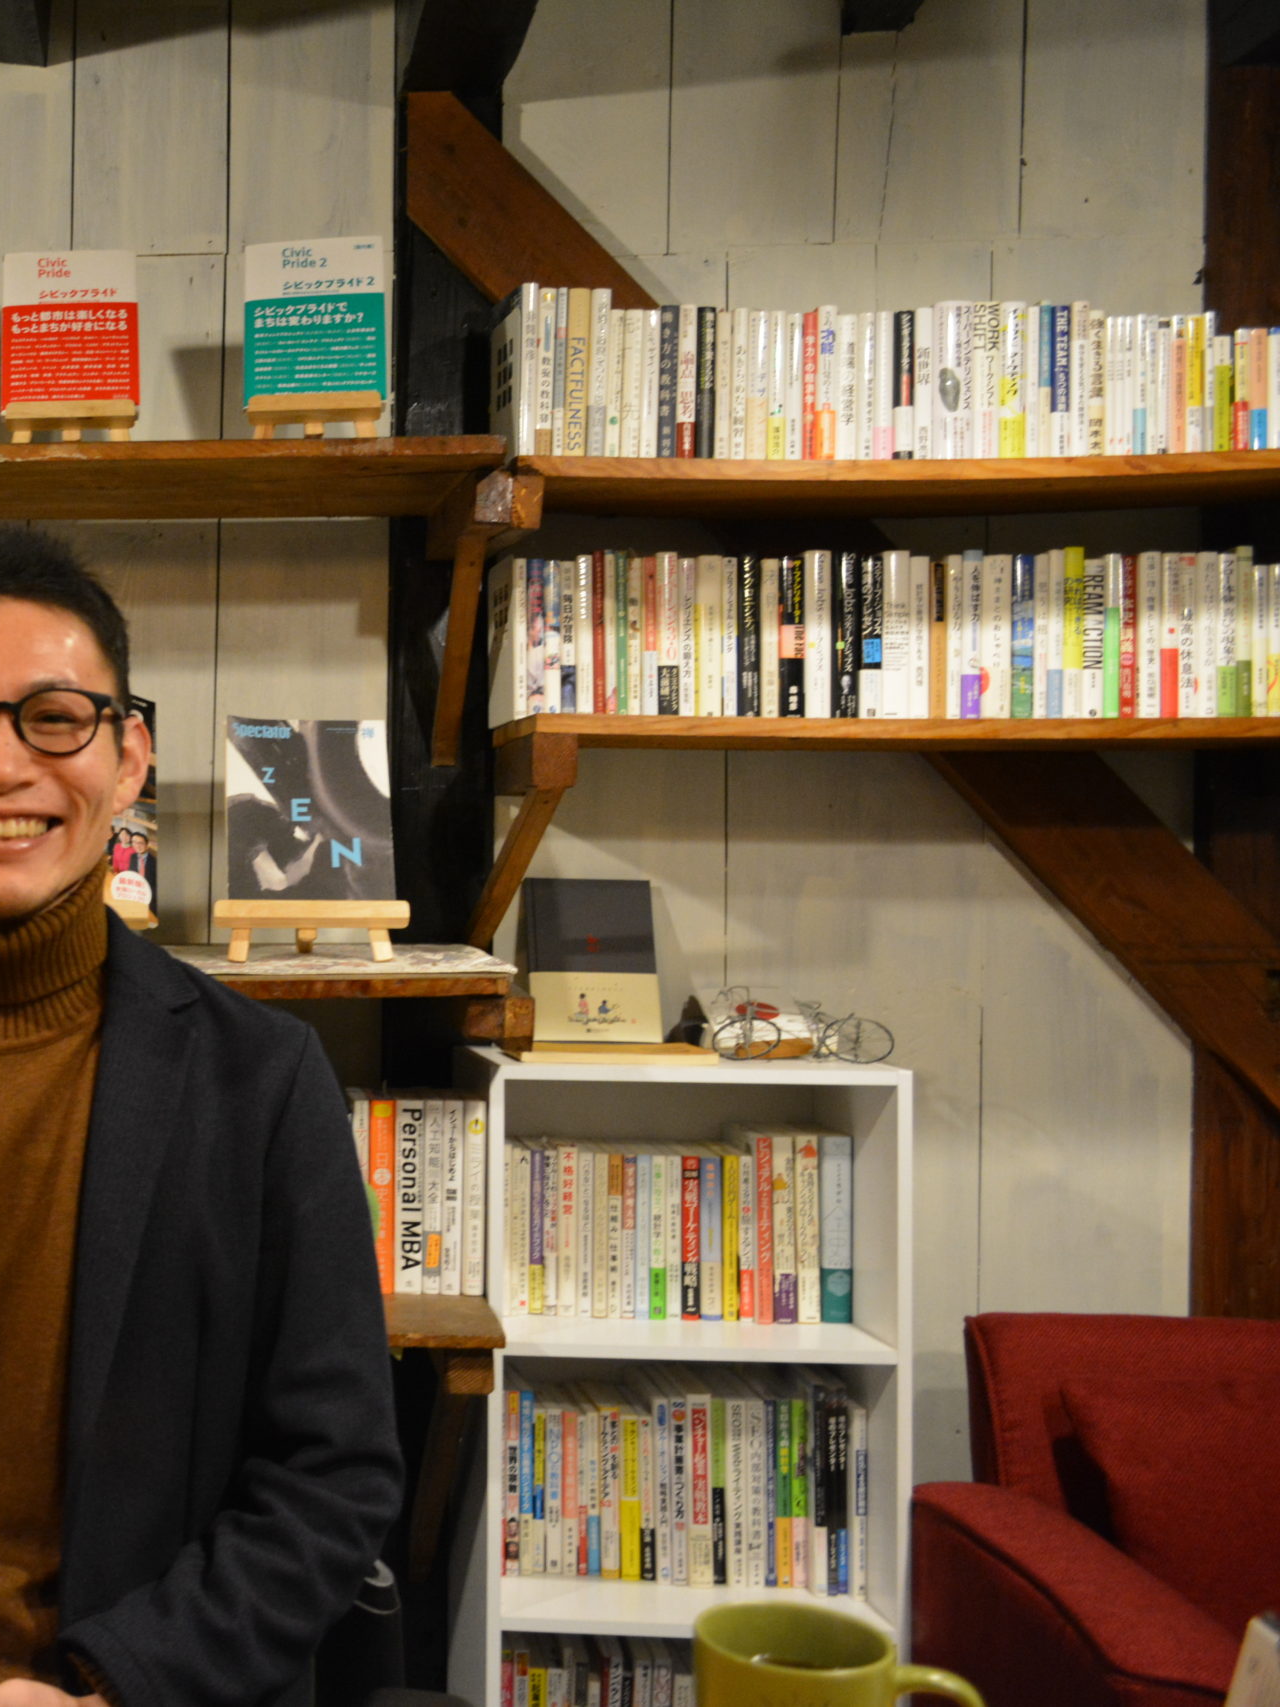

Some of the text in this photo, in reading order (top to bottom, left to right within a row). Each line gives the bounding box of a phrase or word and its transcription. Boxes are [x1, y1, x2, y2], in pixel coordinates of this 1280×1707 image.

[281, 247, 313, 258] Civic
[37, 258, 68, 268] Civic
[281, 257, 328, 269] Pride 2
[37, 268, 72, 279] Pride
[282, 276, 375, 291] シビックプライド 2
[38, 287, 118, 300] シビックプライド
[10, 308, 128, 323] もっと都市は楽しくなる
[253, 301, 348, 317] シビックプライドで
[10, 320, 128, 335] もっとまちが好きになる
[973, 303, 987, 350] SHIFT
[986, 302, 1001, 351] WORK
[1056, 311, 1069, 334] THE
[1055, 336, 1068, 367] TEAM
[566, 336, 587, 452] FACTFULNESS
[843, 551, 857, 615] Steve Jobs
[231, 722, 293, 740] Spectator
[401, 1107, 423, 1271] Personal MBA
